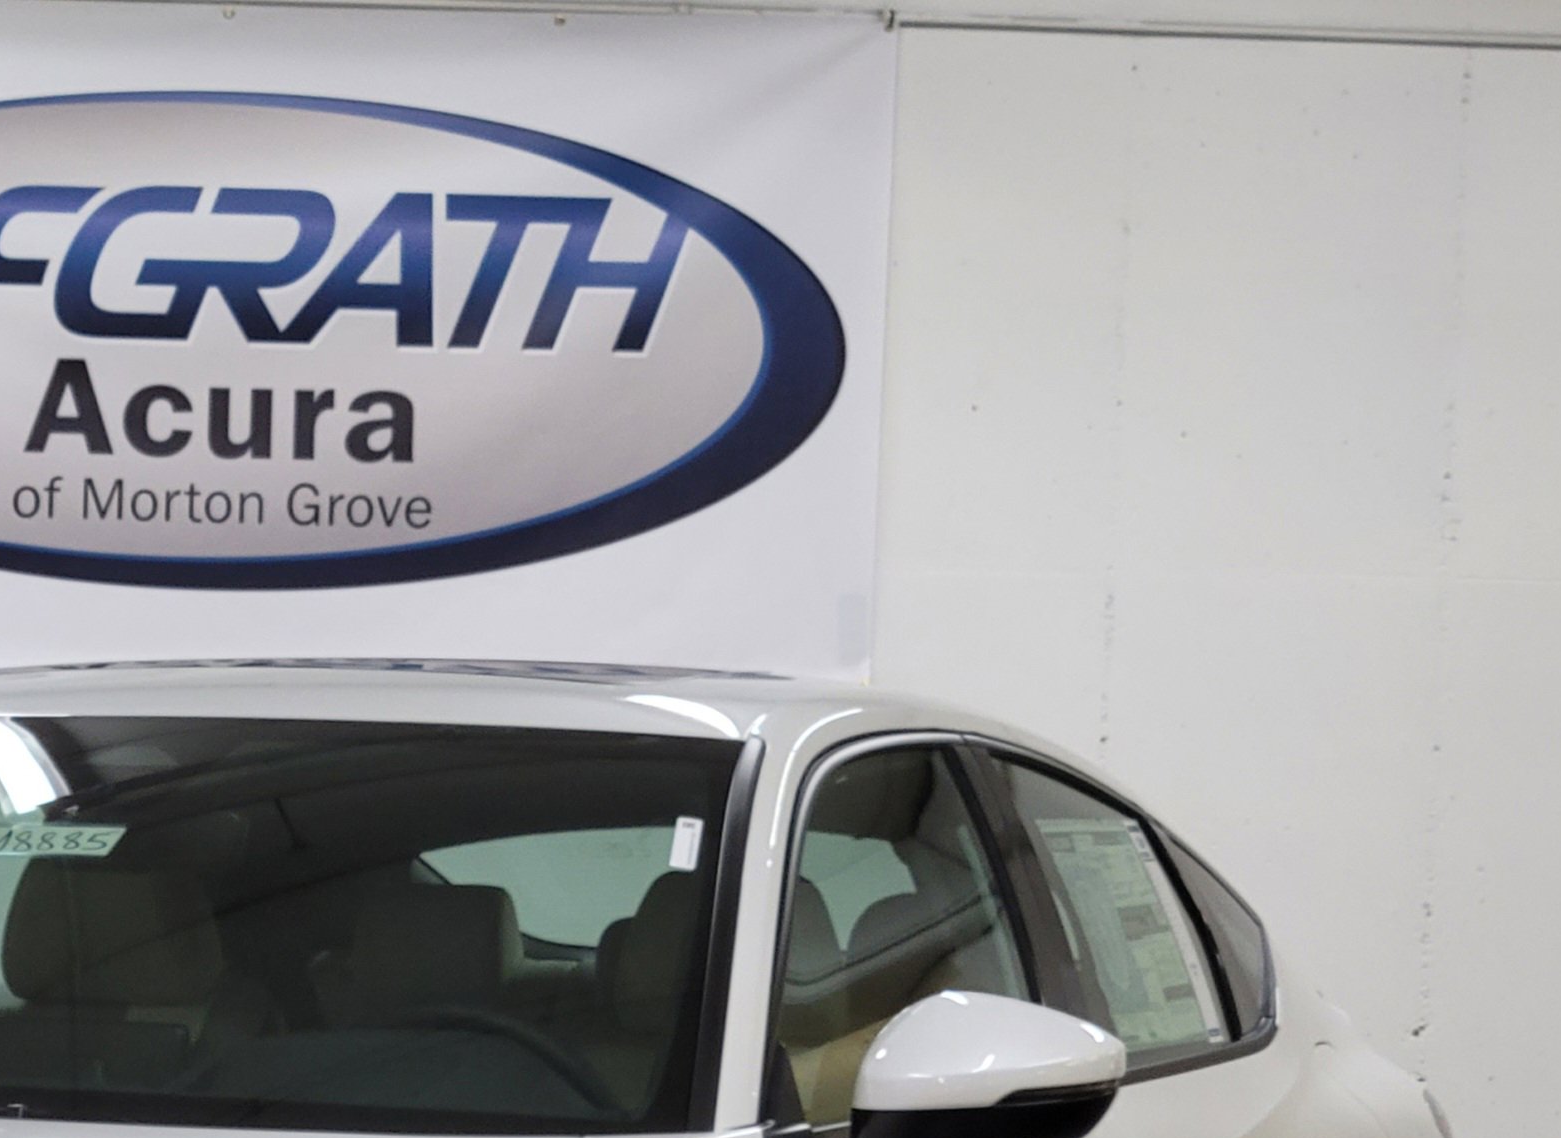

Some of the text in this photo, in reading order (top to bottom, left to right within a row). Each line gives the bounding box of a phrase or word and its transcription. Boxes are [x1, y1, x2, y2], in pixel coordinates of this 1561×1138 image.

[24, 357, 415, 464] Acura
[12, 476, 433, 530] of Morton Grove
